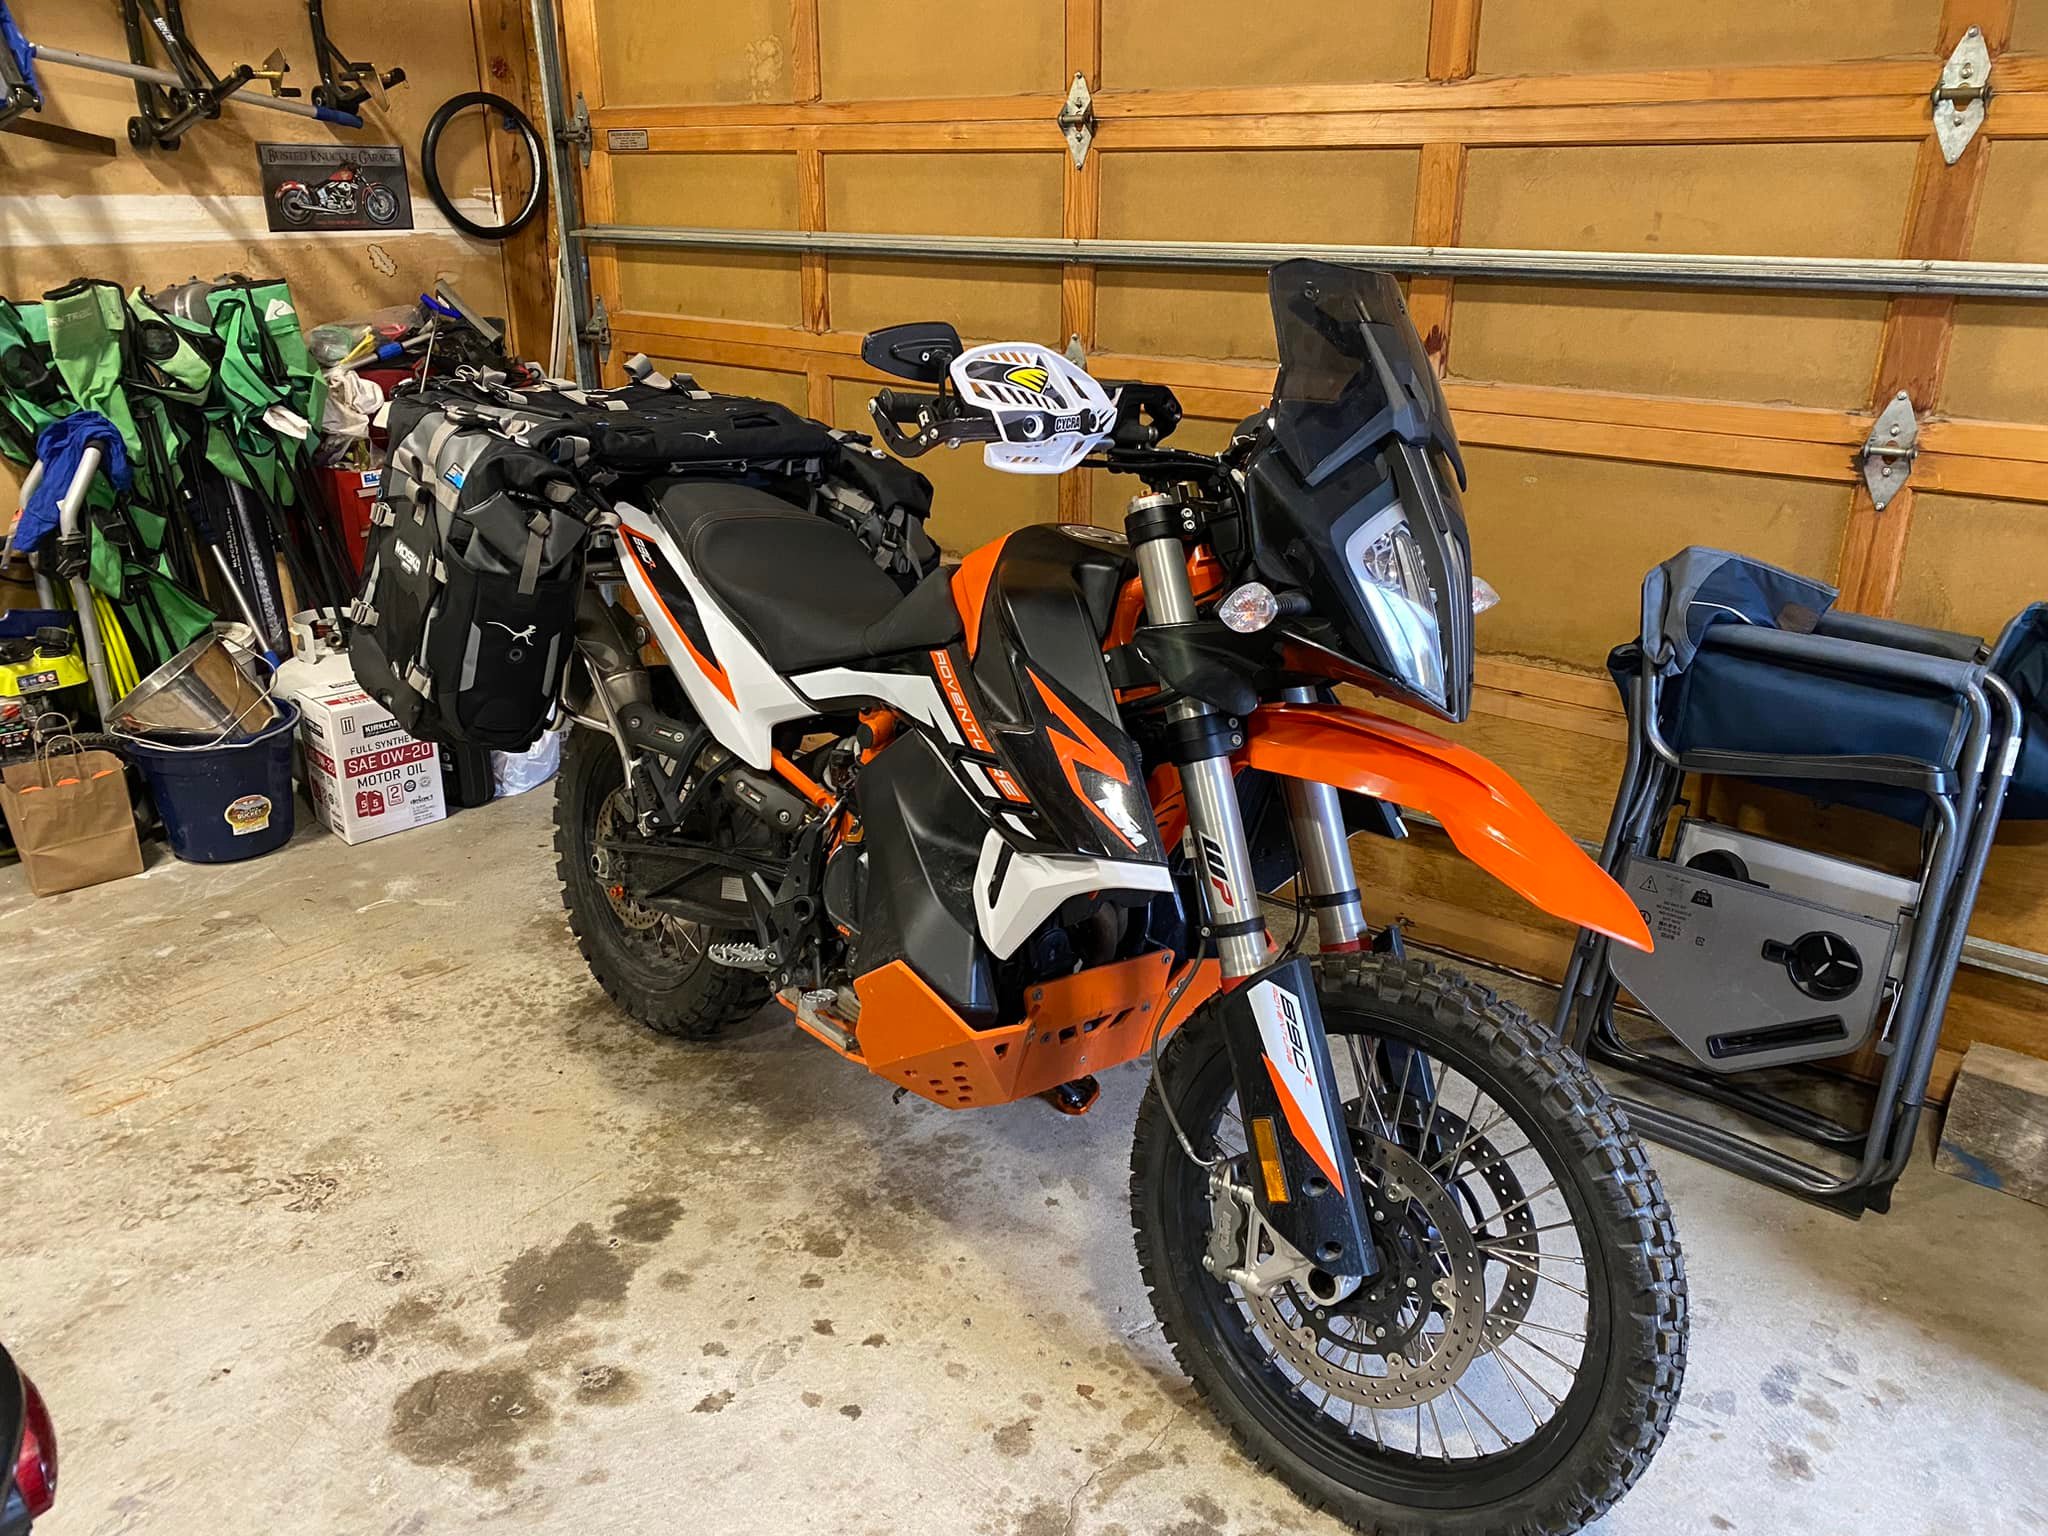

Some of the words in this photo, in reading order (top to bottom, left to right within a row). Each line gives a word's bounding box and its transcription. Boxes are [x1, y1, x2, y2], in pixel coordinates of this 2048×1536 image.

[268, 149, 308, 163] BUSTED
[310, 150, 357, 163] KNUCKLE
[358, 150, 395, 165] GARAGE
[350, 744, 375, 756] FULL
[375, 734, 415, 751] SYNTHE
[348, 755, 378, 774] SAE
[357, 769, 401, 789] MOTOR
[407, 763, 427, 777] OIL
[390, 786, 400, 799] 2
